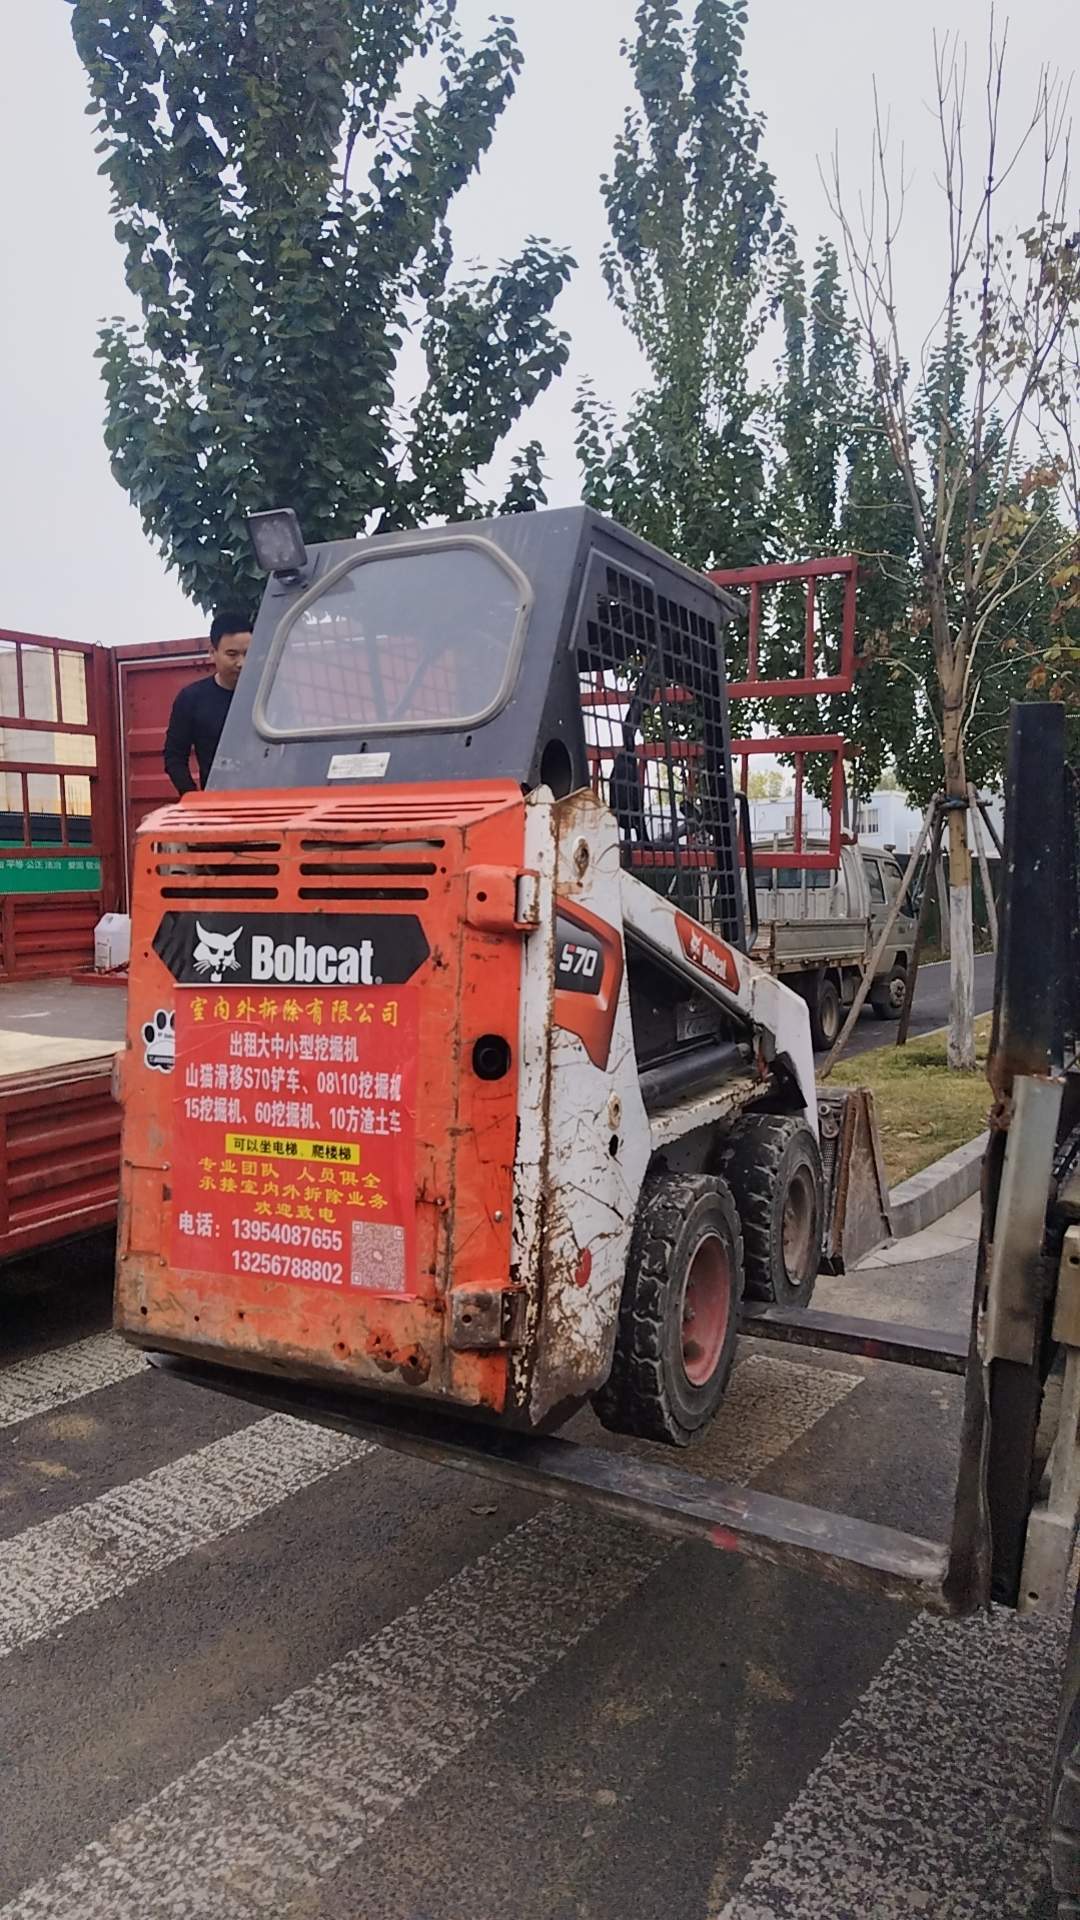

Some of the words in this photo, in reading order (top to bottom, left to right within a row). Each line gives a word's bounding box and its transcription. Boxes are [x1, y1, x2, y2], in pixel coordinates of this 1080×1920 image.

[251, 935, 373, 985] Bobcat
[559, 943, 598, 977] S70
[189, 996, 399, 1027] 室内外拆除有限公司
[229, 1031, 359, 1063] 出租大中小型挖掘机
[198, 1156, 280, 1178] 专业团队
[297, 1166, 381, 1189] 人员俱全
[253, 1201, 337, 1224] 欢迎致电
[231, 1218, 343, 1252] 13954087655
[231, 1250, 343, 1285] 13256788802
